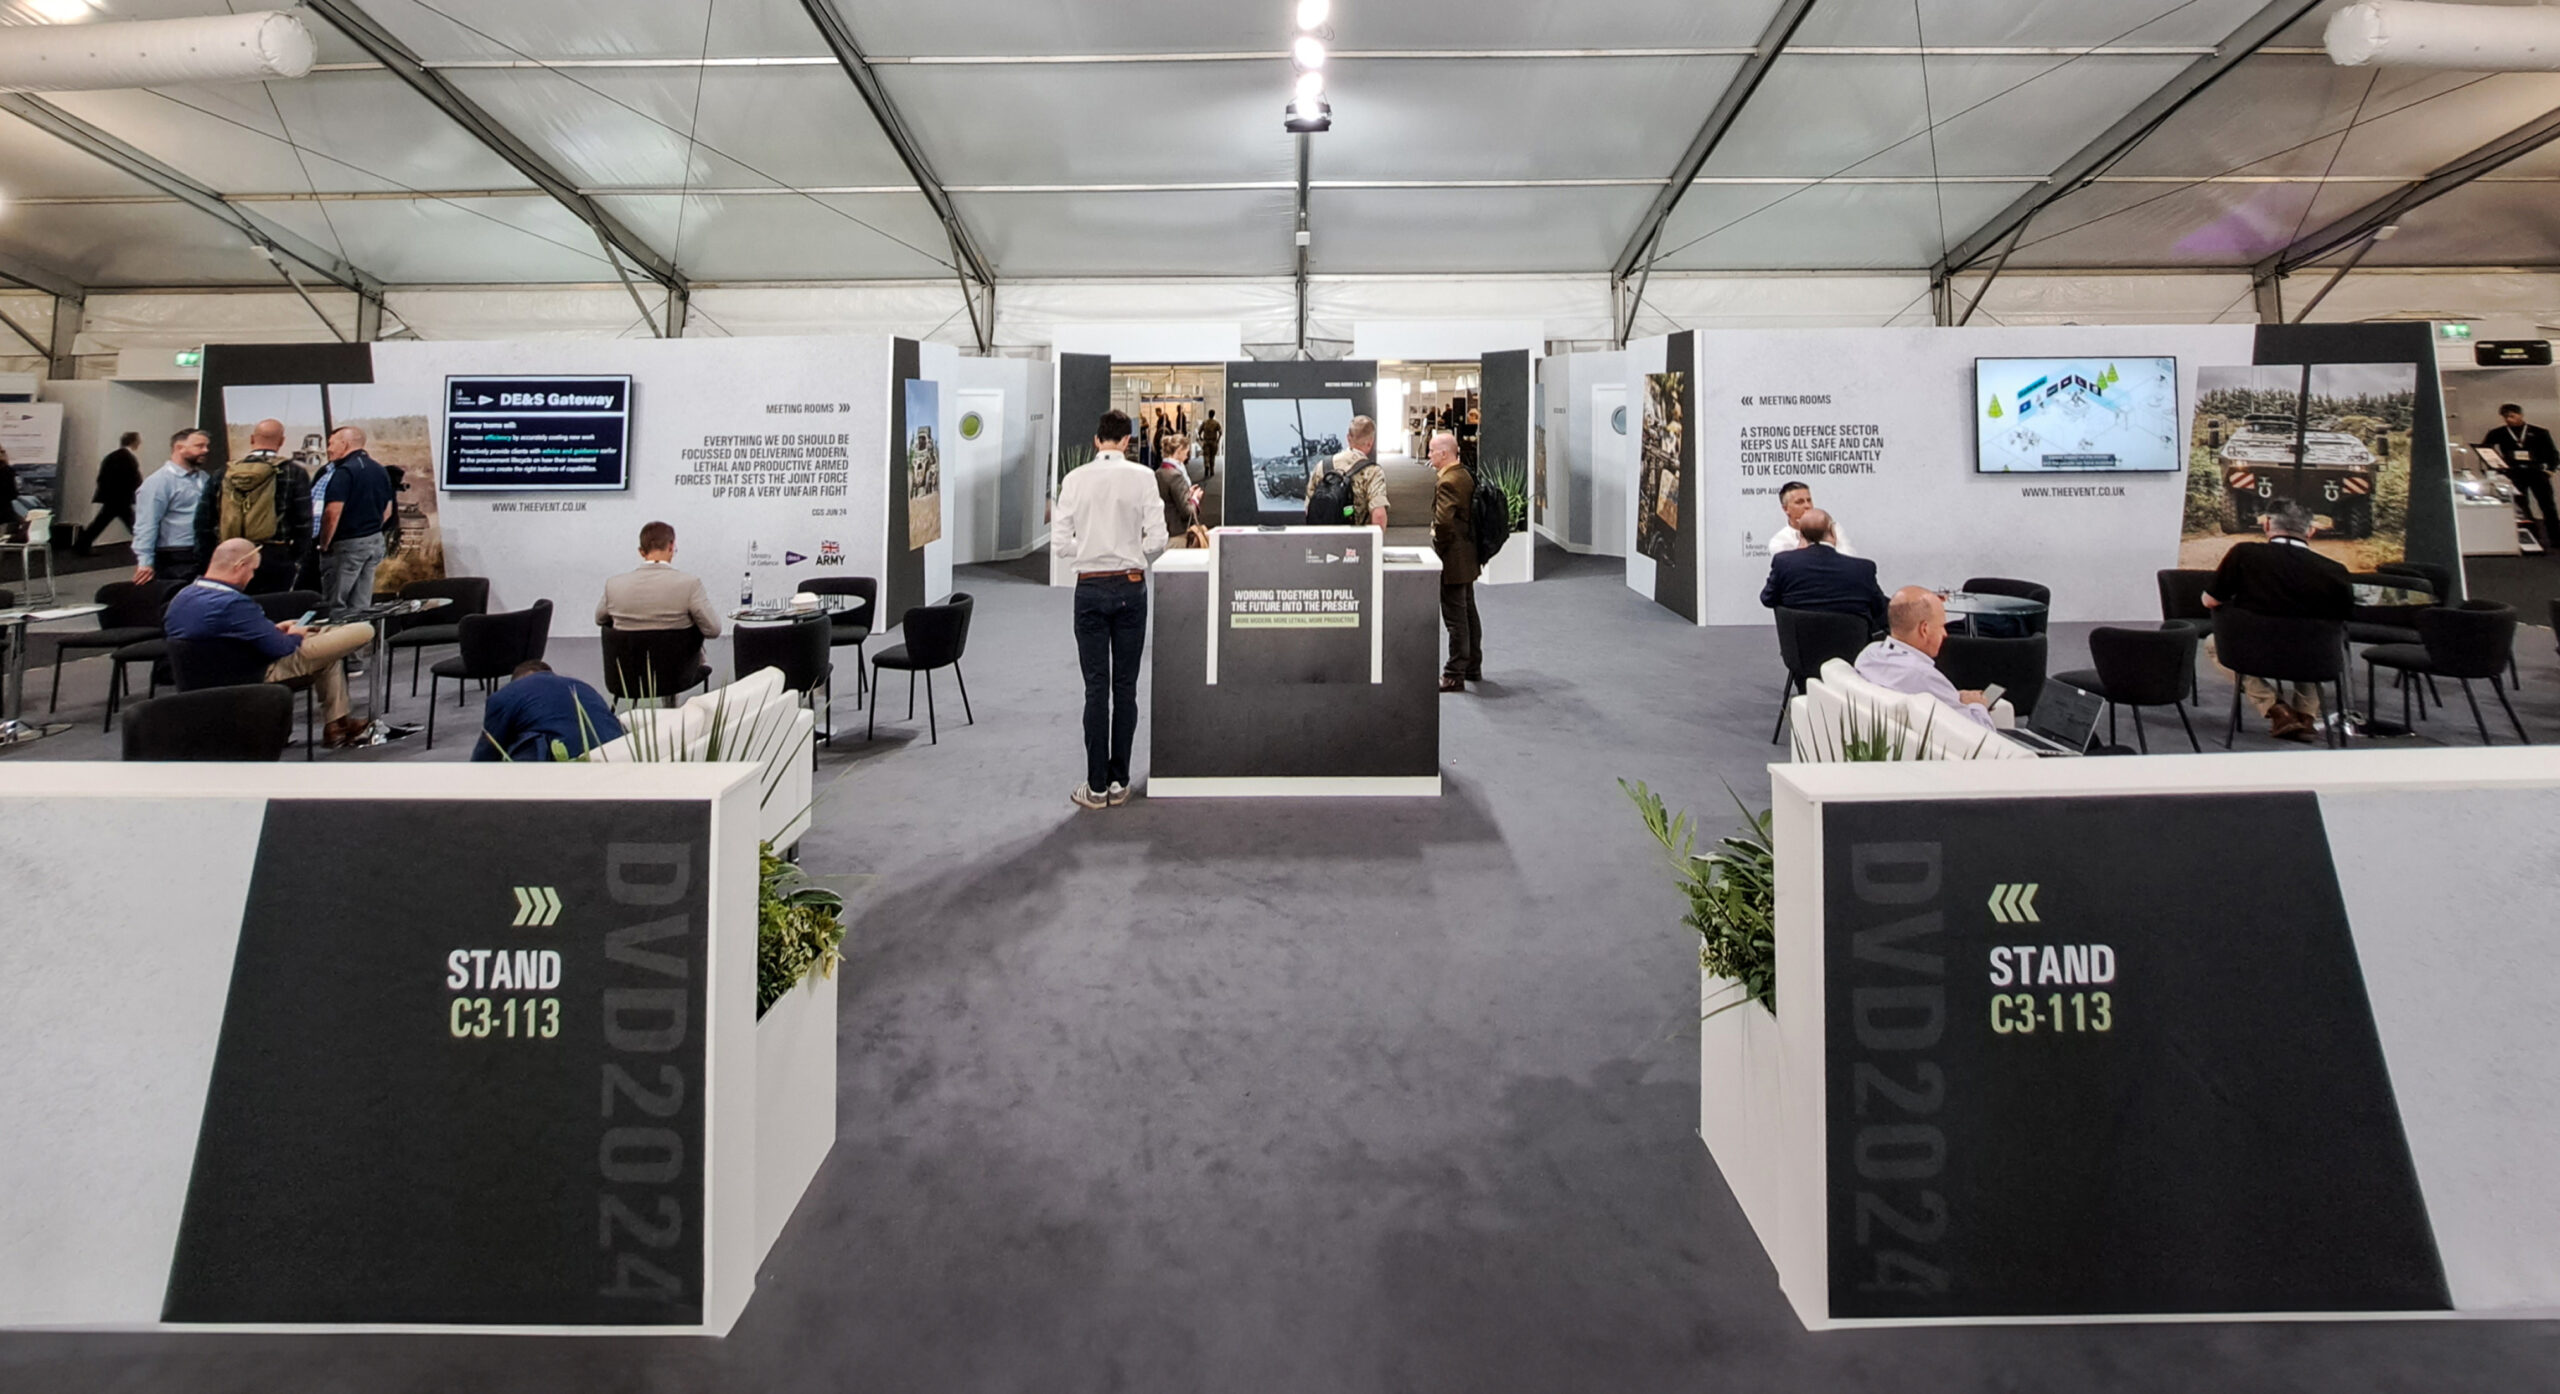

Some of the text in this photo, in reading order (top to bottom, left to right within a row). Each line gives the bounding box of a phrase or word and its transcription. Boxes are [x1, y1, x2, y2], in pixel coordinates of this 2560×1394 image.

[500, 393, 614, 408] DE&S Gateway
[1759, 395, 1831, 406] MEETING ROOMS
[766, 403, 834, 414] MEETING ROOMS
[1740, 424, 1879, 438] A STRONG DEFENCE SECTOR
[704, 433, 850, 447] EVERYTHING WE DO SHOULD BE
[1740, 437, 1884, 450] KEEPS US ALL SAFE AND CAN
[682, 447, 849, 460] FOCUSSED ON DELIVERING MODERN,
[1741, 450, 1881, 463] CONTRIBUTE SIGNIFICANTLY
[694, 460, 849, 473] LETHAL AND PRODUCTIVE ARMED
[1741, 463, 1876, 476] TO UK ECONOMIC GROWTH.
[675, 472, 848, 485] FORCES THAT SETS THE JOINT FORCE
[713, 485, 848, 498] UP FOR A VERY UNFAIR FIGHT
[2022, 487, 2126, 497] WWW.THEEVENT.CO.UK
[492, 502, 587, 512] WWW.THEEVENT.CO.UK
[815, 555, 846, 566] ARMY
[1234, 589, 1354, 600] WORKING TOGETHER TO PULL
[1231, 600, 1360, 612] THE FUTURE INTO THE PRESENT
[447, 949, 562, 990] STAND
[1989, 944, 2115, 986] STAND
[450, 997, 561, 1039] C3-113
[1990, 991, 2113, 1033] C3-113
[600, 842, 692, 1298] DVD2024
[1851, 841, 1949, 1296] DVD2024
